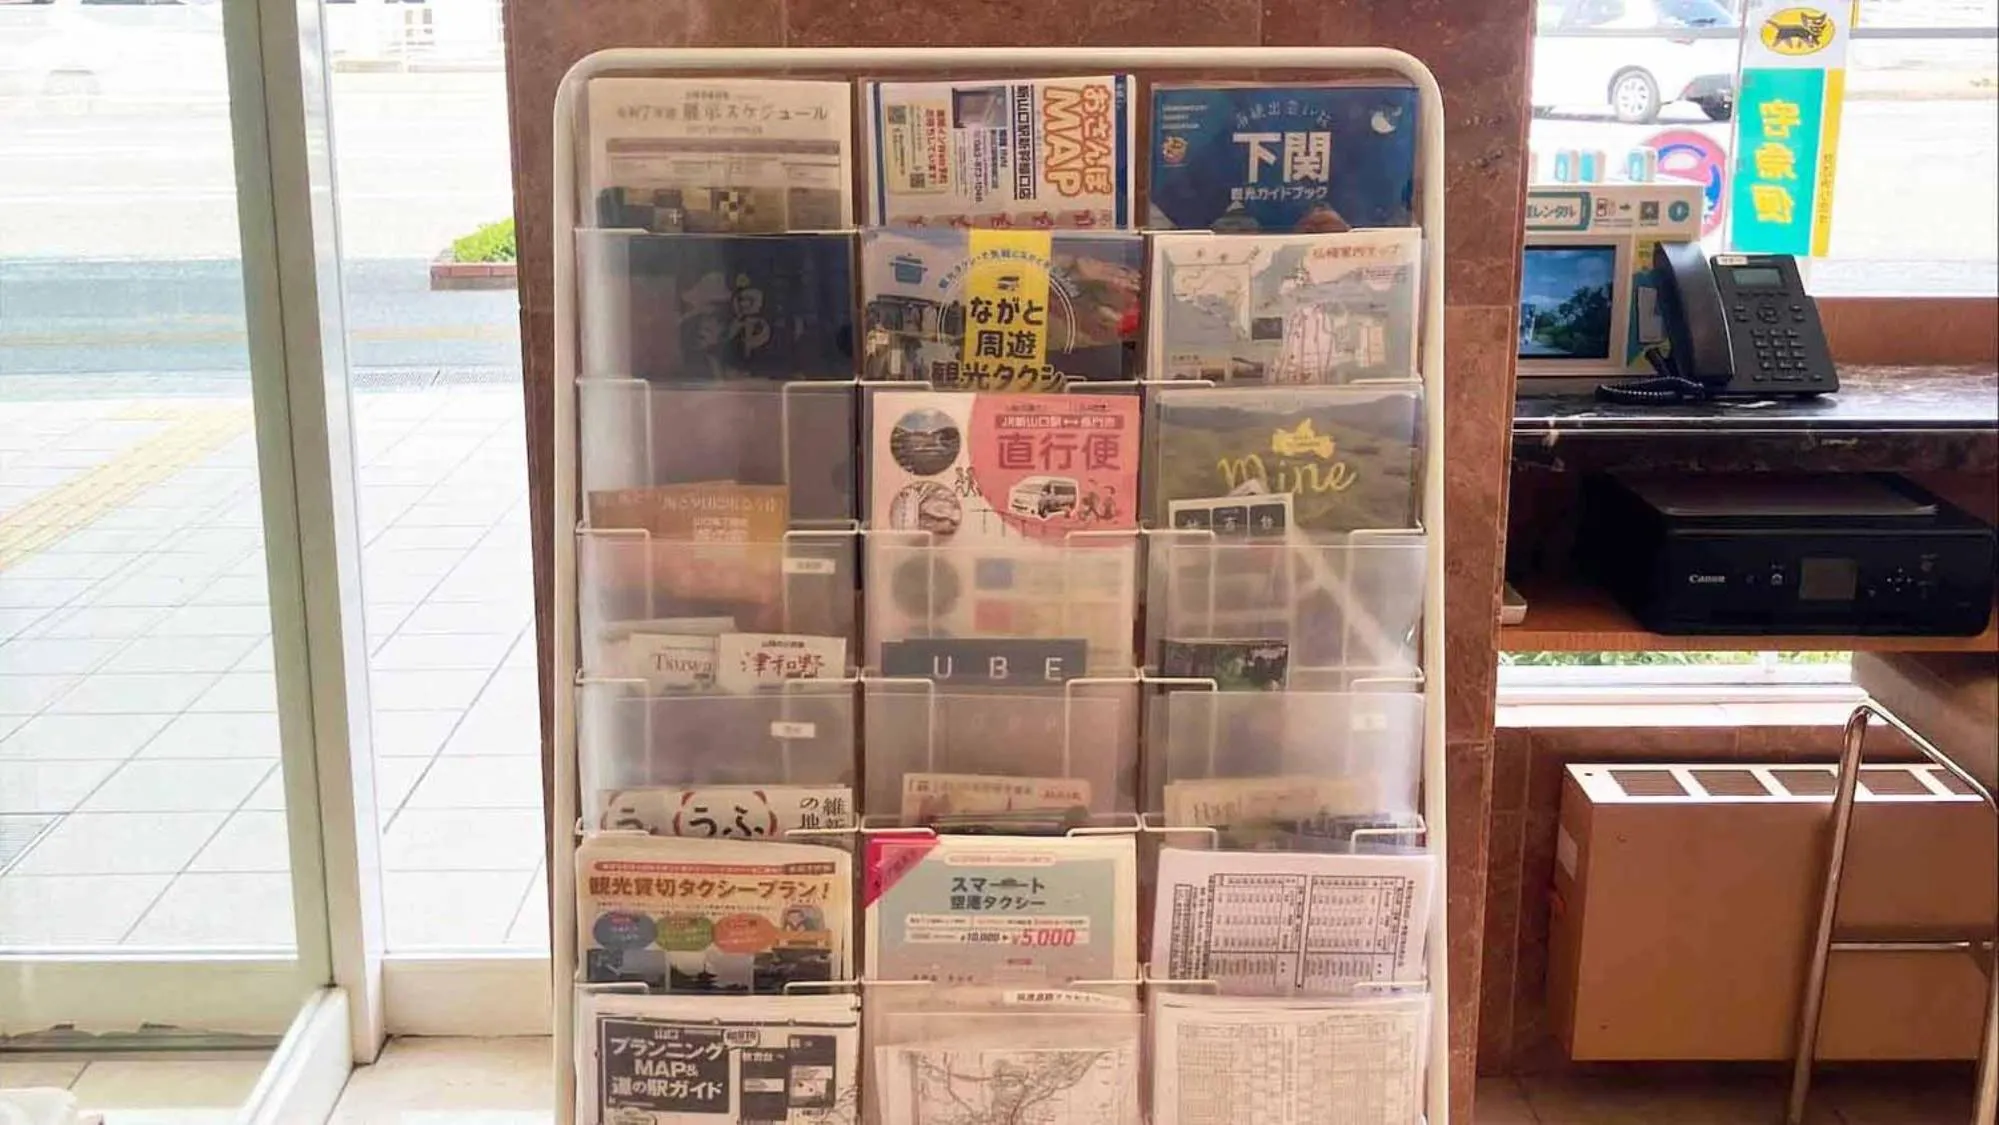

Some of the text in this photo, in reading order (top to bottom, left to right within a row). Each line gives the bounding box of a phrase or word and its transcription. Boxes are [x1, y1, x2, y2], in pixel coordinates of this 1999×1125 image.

[1043, 85, 1086, 198] MAP
[1082, 83, 1113, 196] おさんぽ
[1232, 131, 1332, 183] 下関
[970, 297, 1044, 325] ながと
[975, 331, 1037, 359] 周遊
[995, 432, 1123, 471] 直行便
[1217, 453, 1357, 495] Mine
[1688, 574, 1726, 584] Canon
[933, 655, 1064, 681] UBE
[610, 1036, 722, 1061] プランニング
[612, 1077, 724, 1100] 道の駅ガイド
